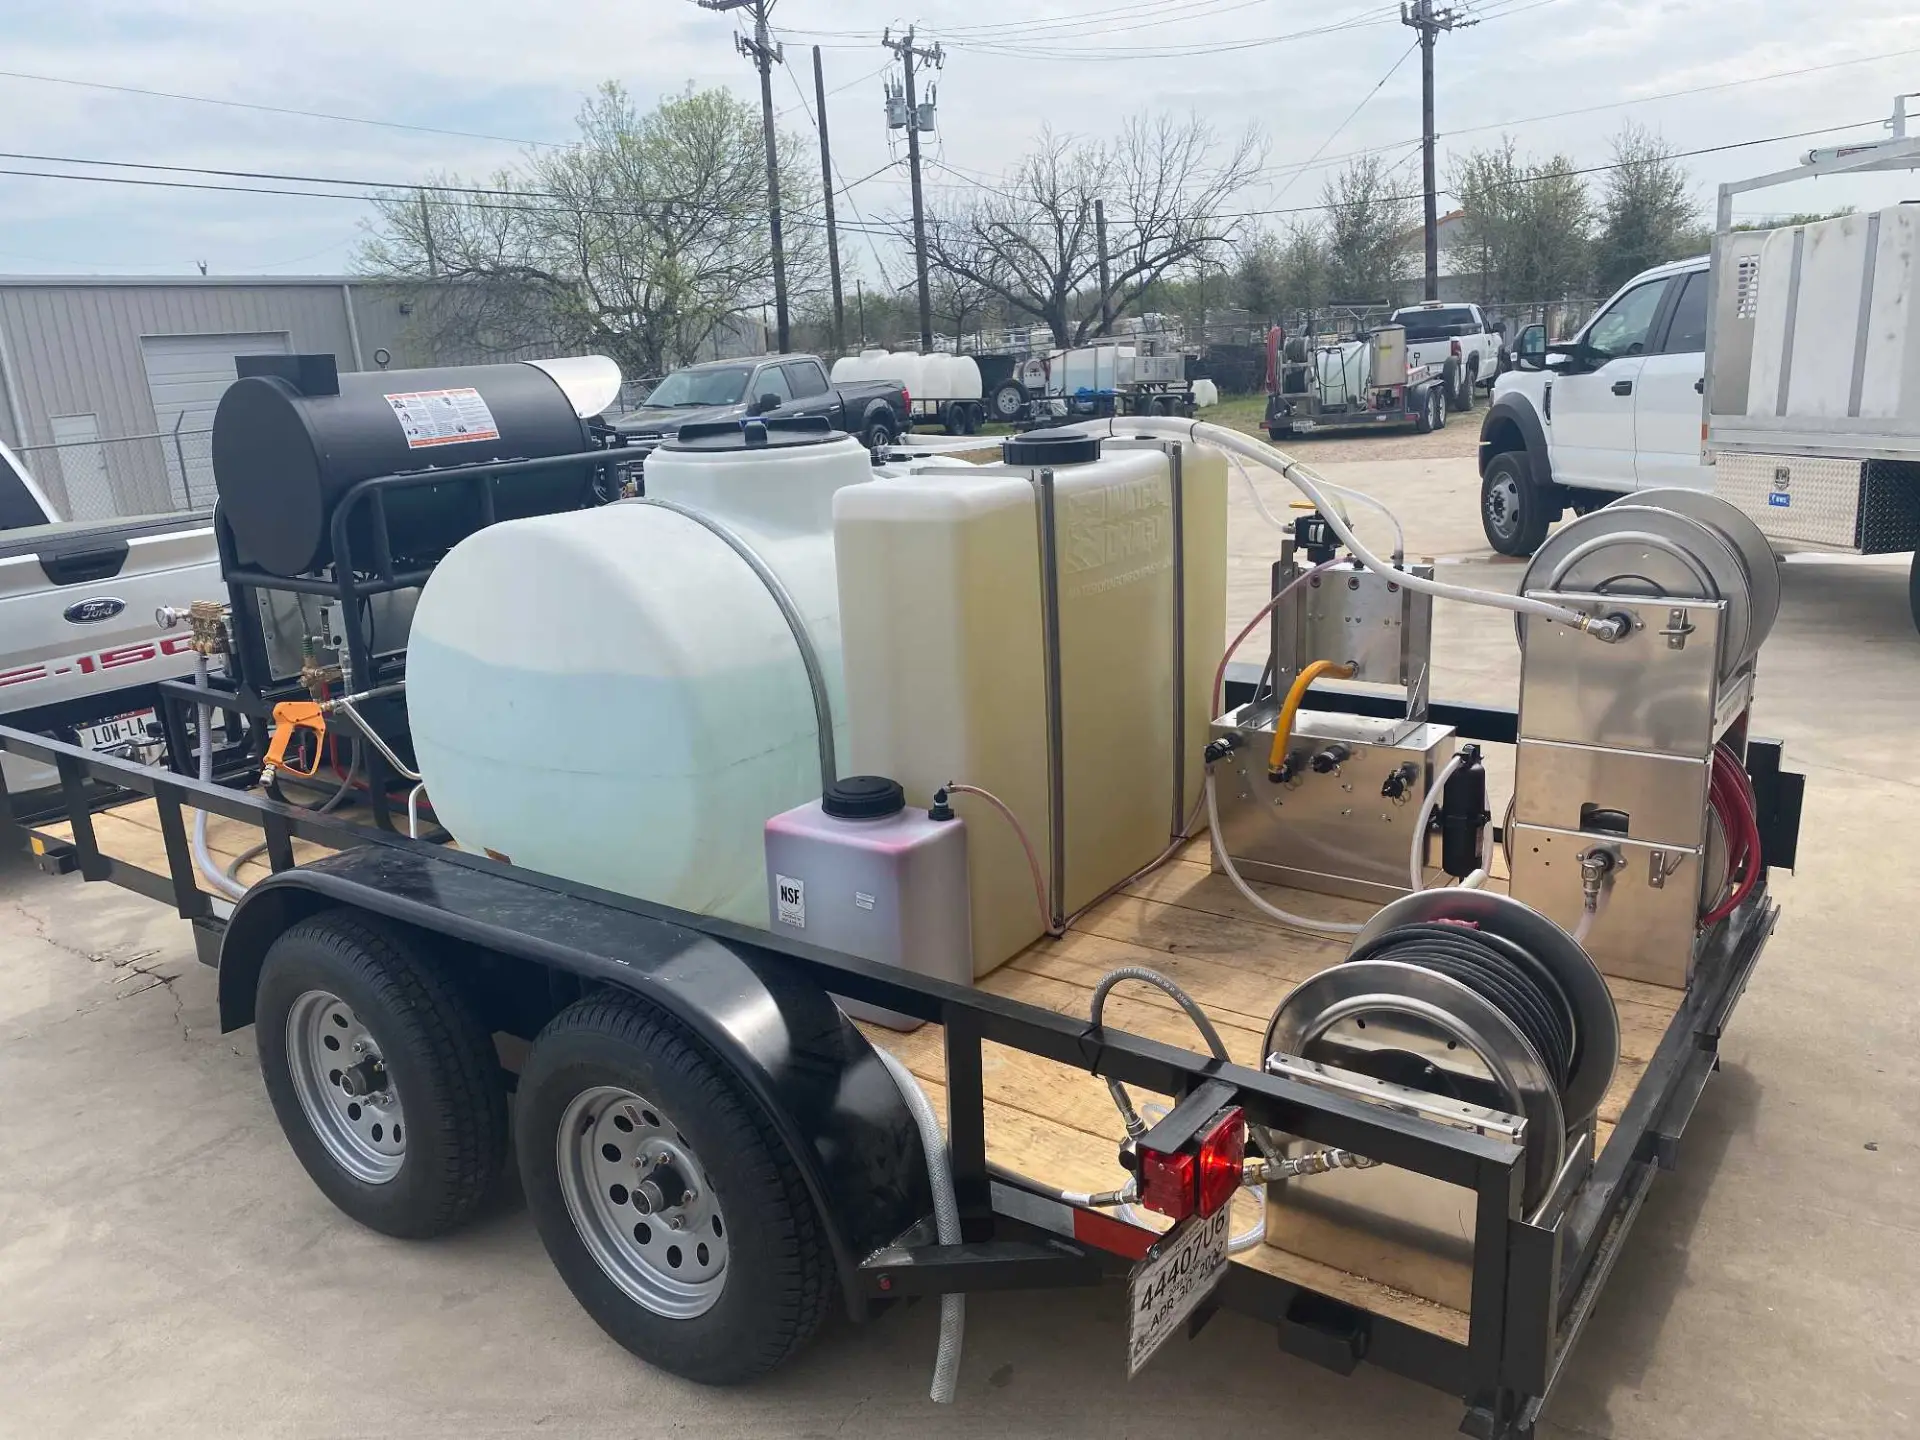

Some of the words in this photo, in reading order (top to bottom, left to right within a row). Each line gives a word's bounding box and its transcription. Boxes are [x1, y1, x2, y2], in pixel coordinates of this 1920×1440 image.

[81, 602, 114, 619] Ford
[780, 885, 800, 905] NSF
[1140, 1206, 1225, 1312] 44407U6
[1150, 1297, 1174, 1332] APR
